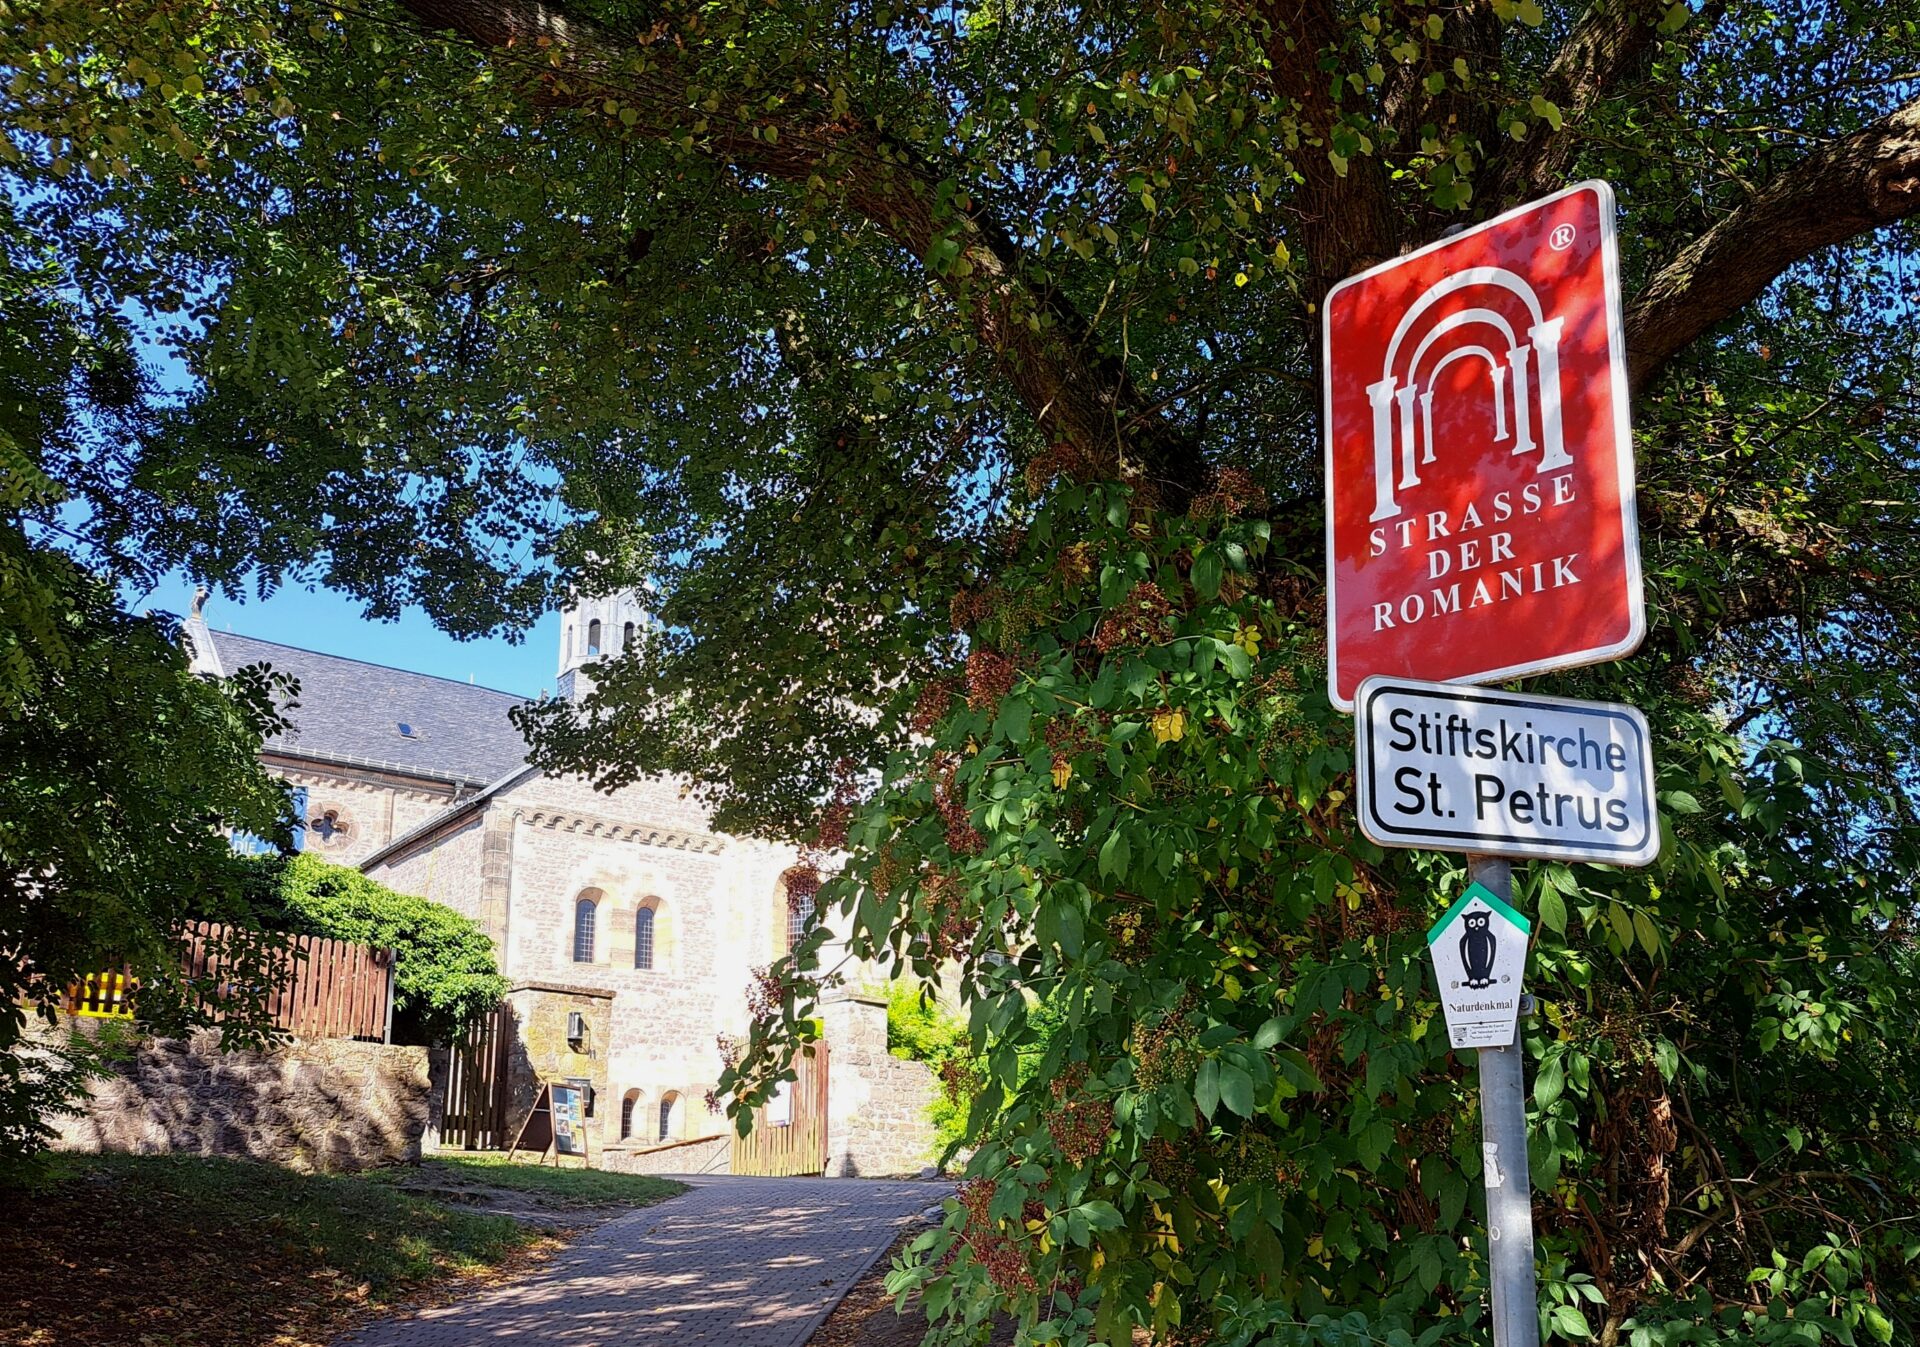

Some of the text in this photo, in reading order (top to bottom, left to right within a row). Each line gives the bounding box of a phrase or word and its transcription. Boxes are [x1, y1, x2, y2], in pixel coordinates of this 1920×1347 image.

[1369, 473, 1576, 558] STRASSE
[1427, 532, 1516, 580] DER
[1371, 553, 1582, 633] ROMANIK
[1389, 708, 1627, 773] Stiftskirche
[1393, 766, 1630, 833] St. Petrus
[1449, 999, 1513, 1013] Naturdenkmal
